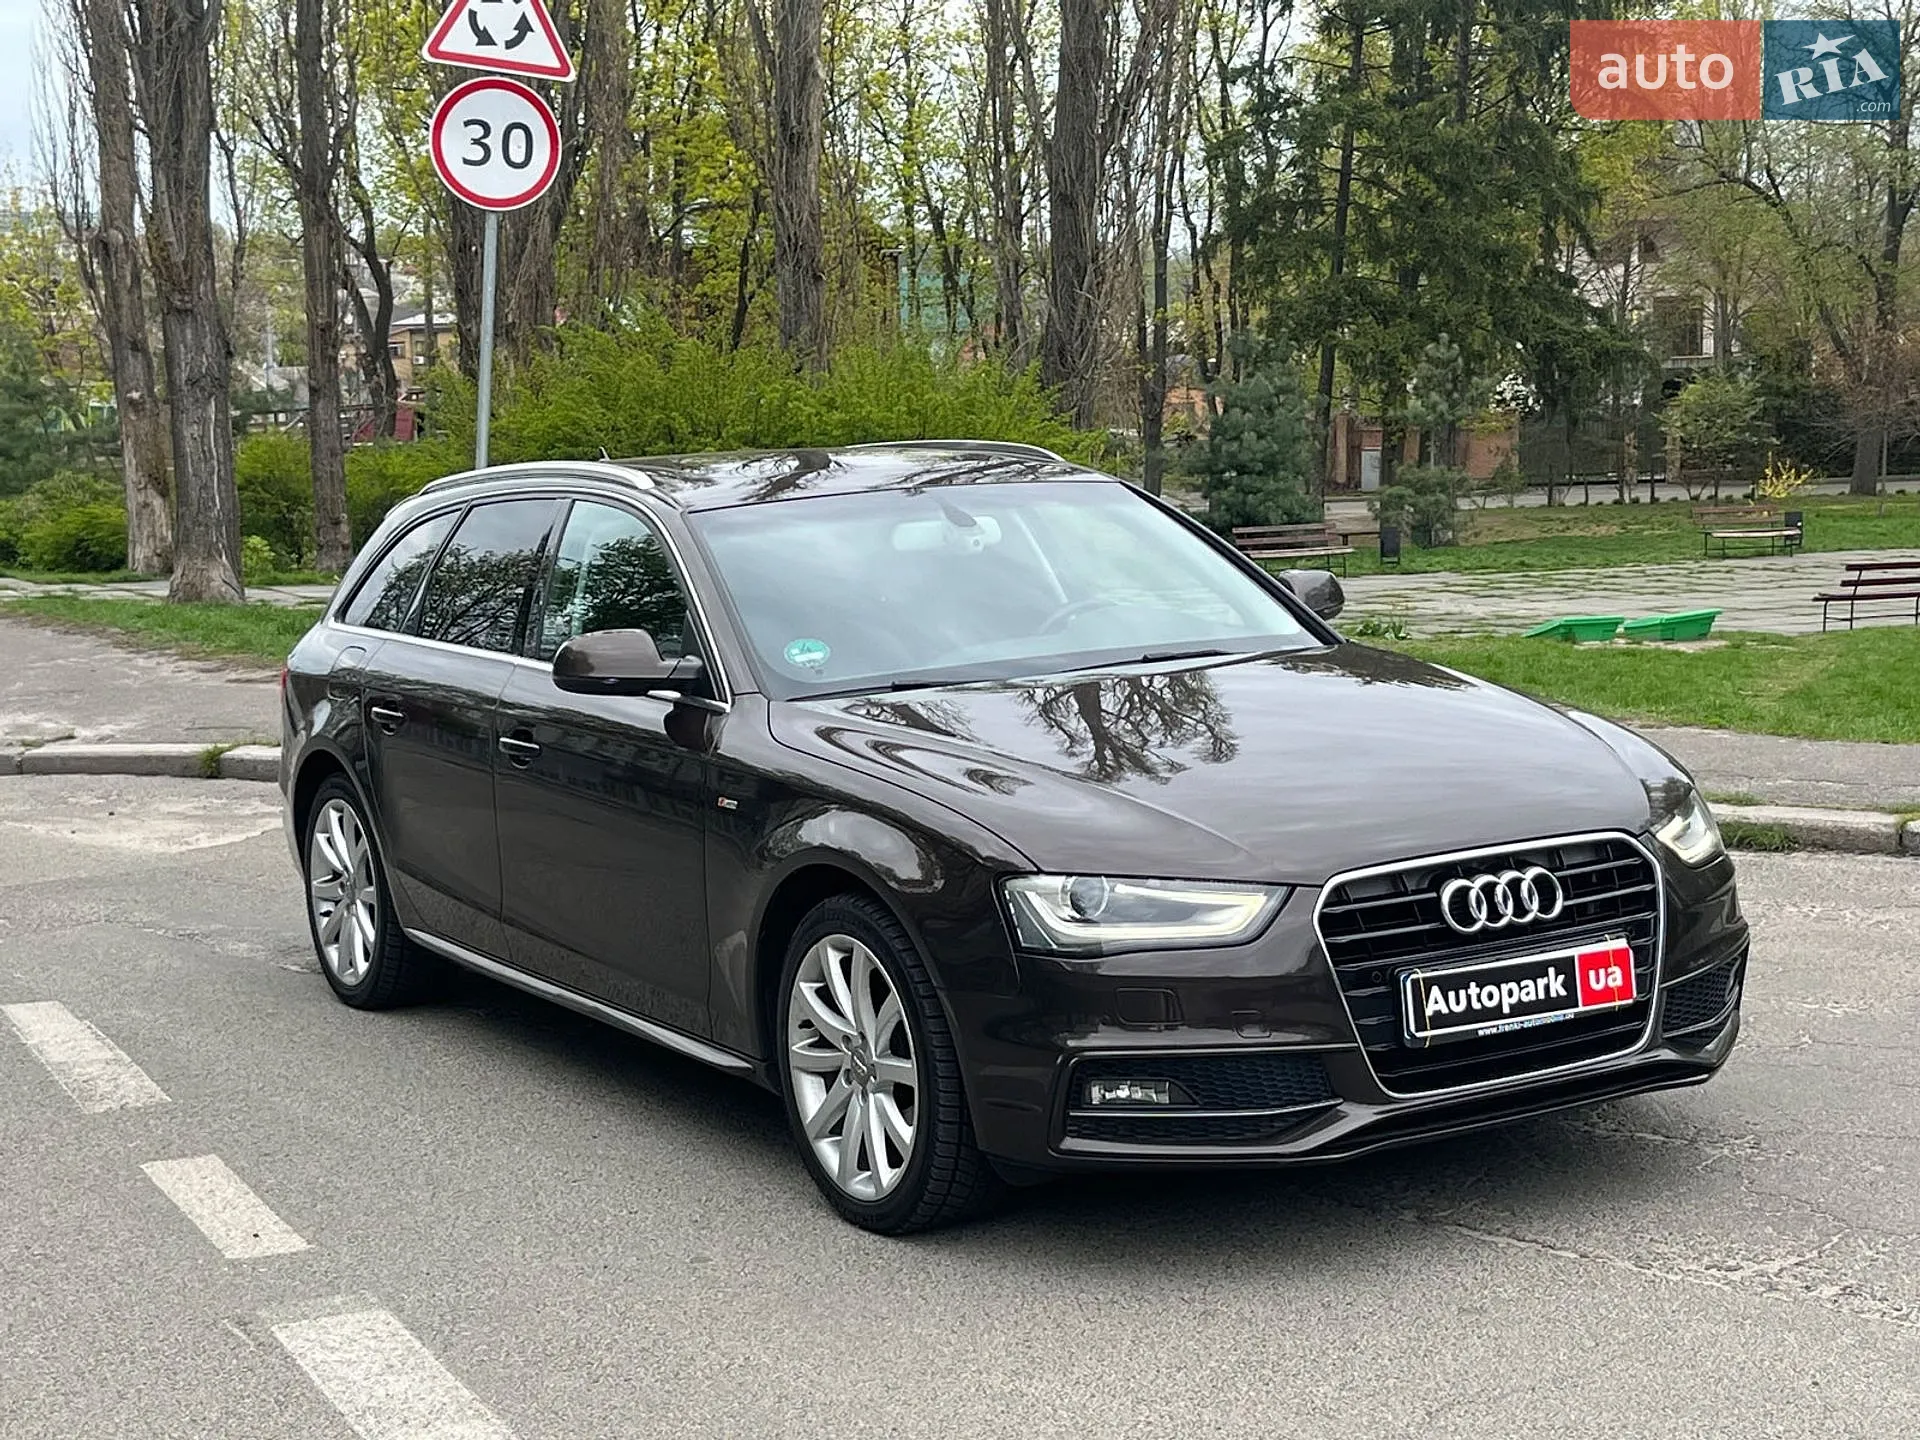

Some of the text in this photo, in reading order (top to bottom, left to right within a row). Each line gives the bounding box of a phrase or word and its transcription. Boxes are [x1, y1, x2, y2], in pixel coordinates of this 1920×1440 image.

[462, 118, 534, 170] 30
[1427, 966, 1624, 1017] Autopark ua
